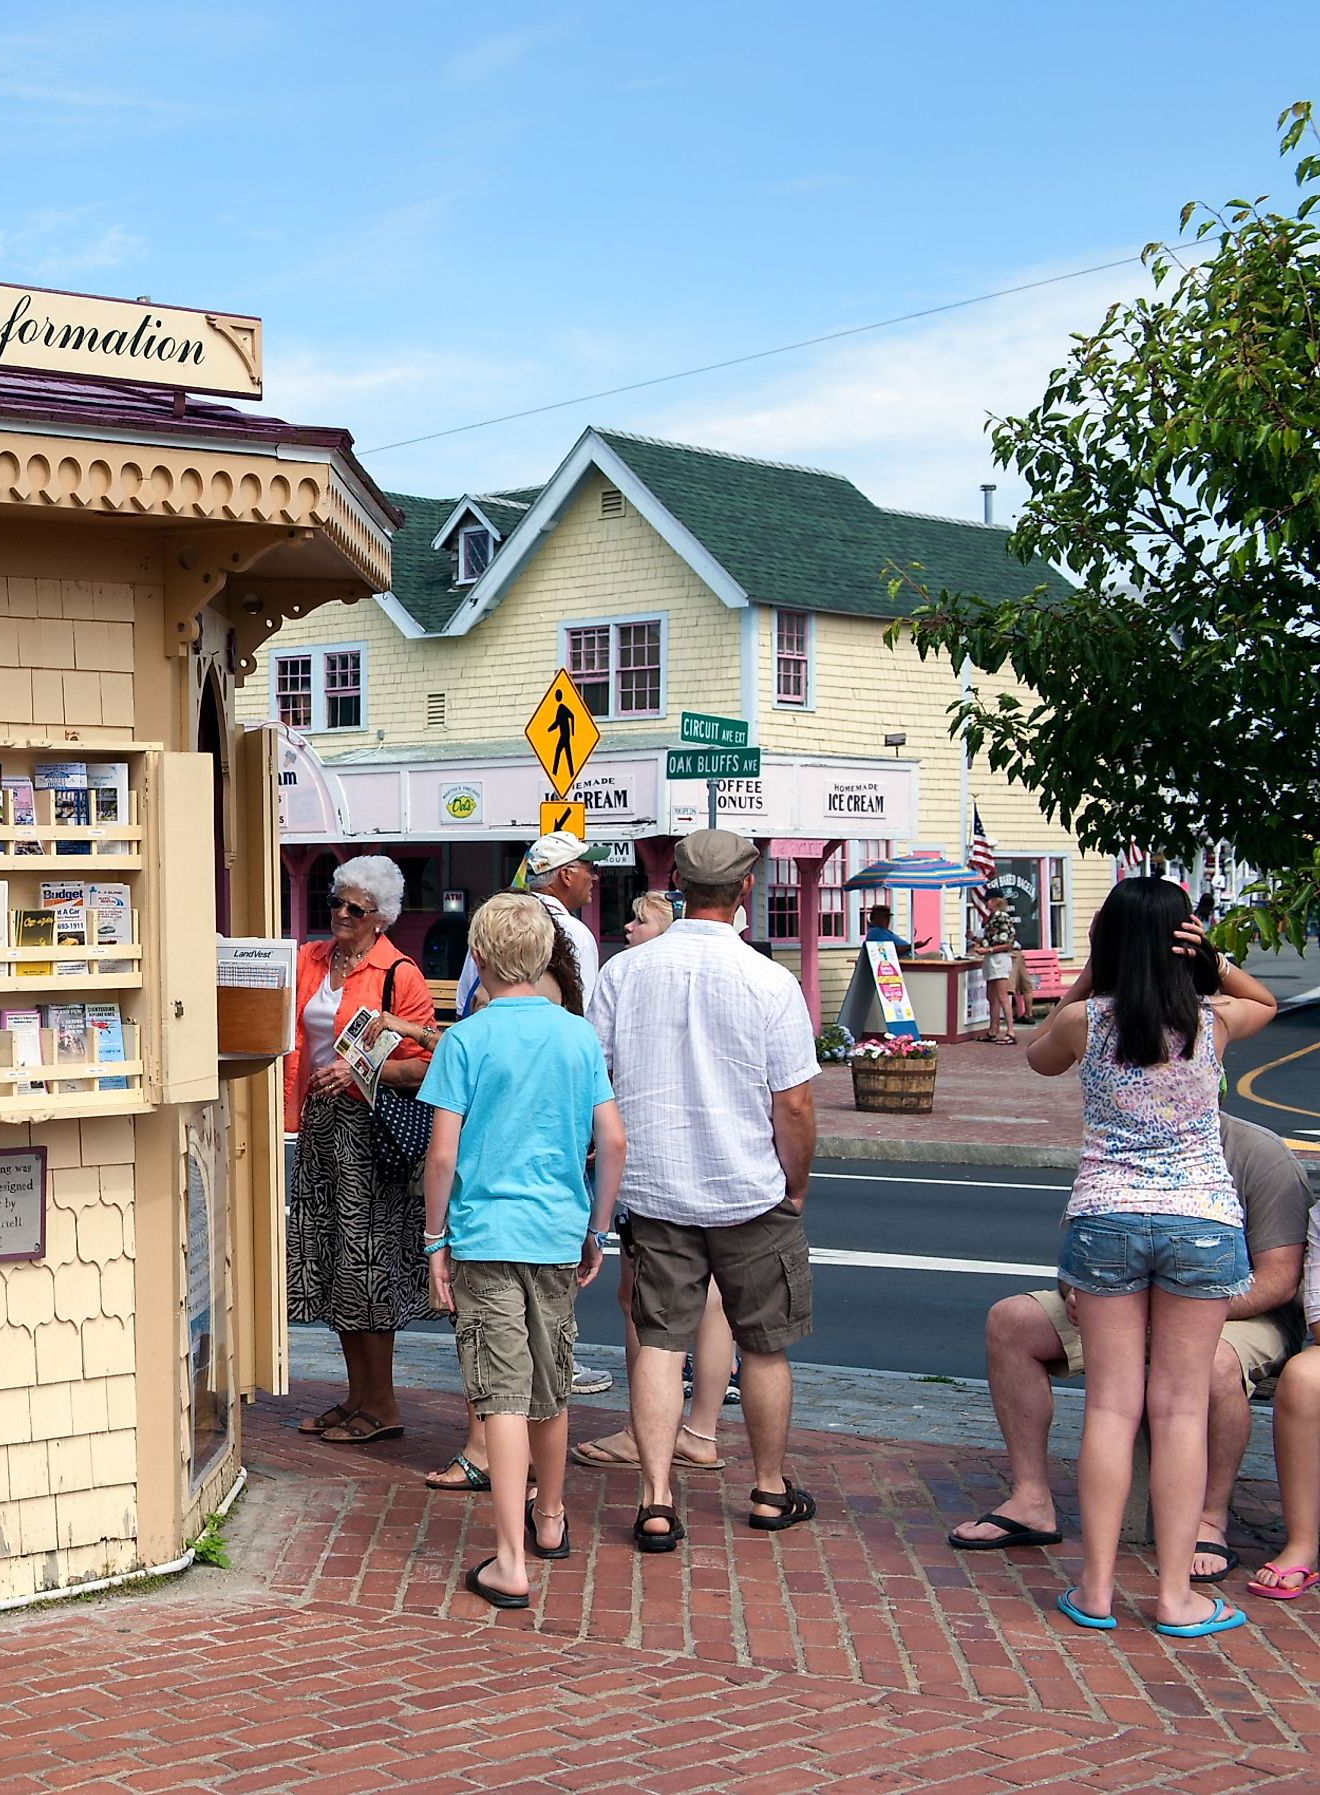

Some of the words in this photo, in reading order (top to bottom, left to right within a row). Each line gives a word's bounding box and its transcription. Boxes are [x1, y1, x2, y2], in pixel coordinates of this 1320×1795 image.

[684, 718, 720, 740] CIRCUIT
[721, 730, 734, 743] AVE
[734, 731, 746, 744] EXT
[668, 756, 693, 774] OAK
[697, 754, 740, 773] BLUFFS
[743, 759, 758, 772] AVE
[573, 777, 615, 790] EMADE
[834, 783, 878, 792] HOMEMADE
[716, 796, 763, 809] ONUTS
[828, 793, 845, 811] ICE
[846, 794, 884, 813] CREAM
[43, 889, 84, 900] Budget
[445, 893, 463, 901] ATM
[233, 950, 271, 958] LandVest
[14, 1164, 32, 1173] was
[4, 1197, 17, 1212] by
